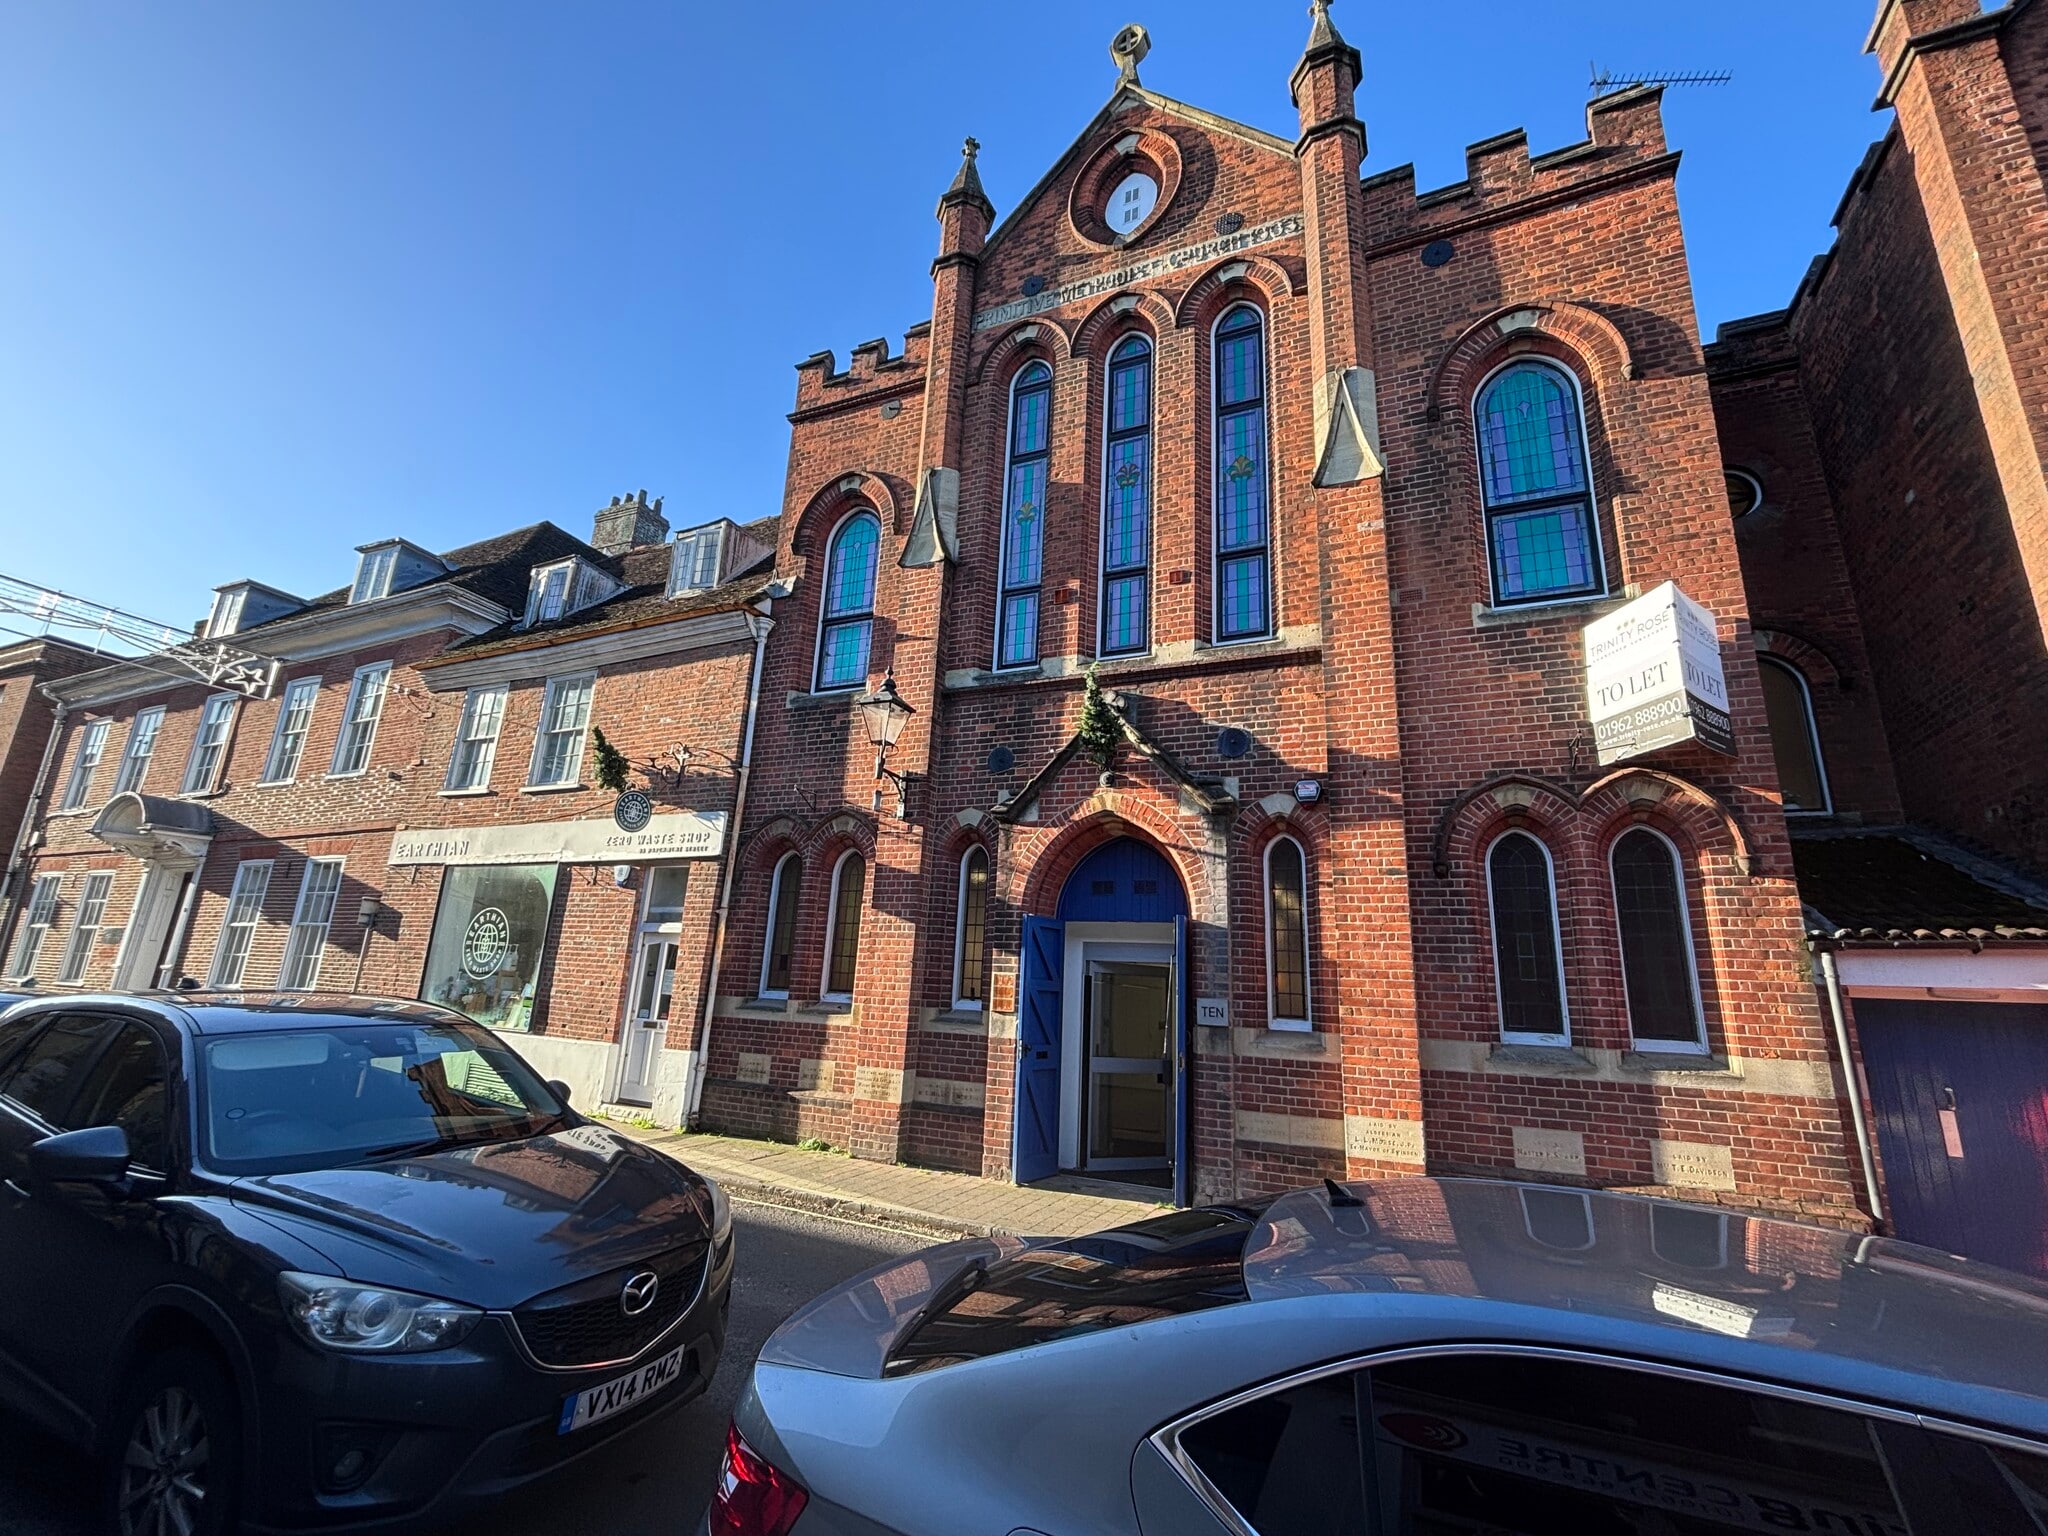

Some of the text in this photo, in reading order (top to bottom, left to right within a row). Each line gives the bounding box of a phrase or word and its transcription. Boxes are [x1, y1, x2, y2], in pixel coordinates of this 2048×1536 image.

[973, 291, 1055, 331] PRIMITIVE
[1590, 628, 1634, 657] TRINITY
[1637, 610, 1670, 635] ROSE
[1597, 661, 1669, 706] TO LET
[1684, 660, 1722, 699] TO LET
[1598, 697, 1681, 739] 01962 888900
[396, 841, 470, 858] EARTHIAN
[606, 832, 711, 847] ZERO WASTE SHOP
[469, 912, 506, 939] EARTHIAN
[1200, 1005, 1225, 1019] TEN
[588, 1350, 680, 1419] VX14 RMZ
